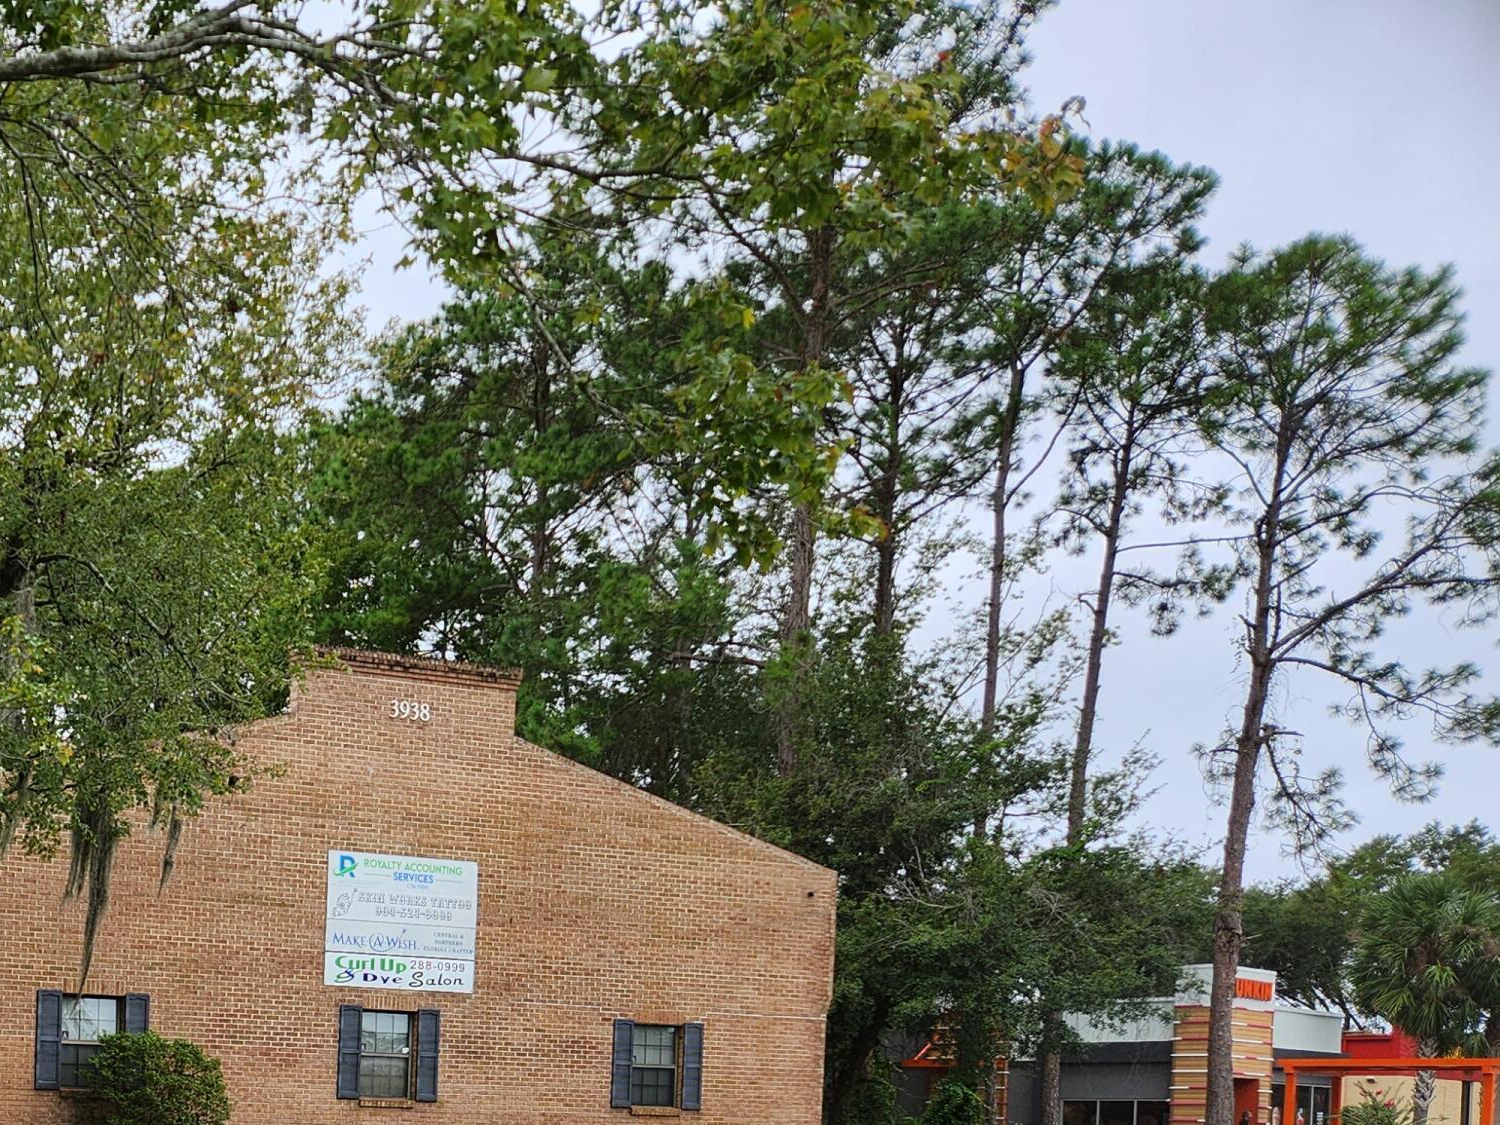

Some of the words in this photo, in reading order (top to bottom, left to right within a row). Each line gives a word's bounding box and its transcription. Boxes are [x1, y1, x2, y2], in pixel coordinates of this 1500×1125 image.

[389, 700, 430, 721] 3938
[364, 859, 402, 870] ROYALTY
[405, 863, 463, 876] ACCOUNTING
[393, 872, 435, 884] SERVICES
[389, 894, 427, 907] WORKS
[430, 897, 472, 910] TATTOO
[335, 956, 375, 971] Curl
[379, 958, 407, 974] Up
[410, 960, 466, 972] 288-0999
[409, 972, 464, 988] Salon
[1234, 978, 1273, 1001] UNKIN
